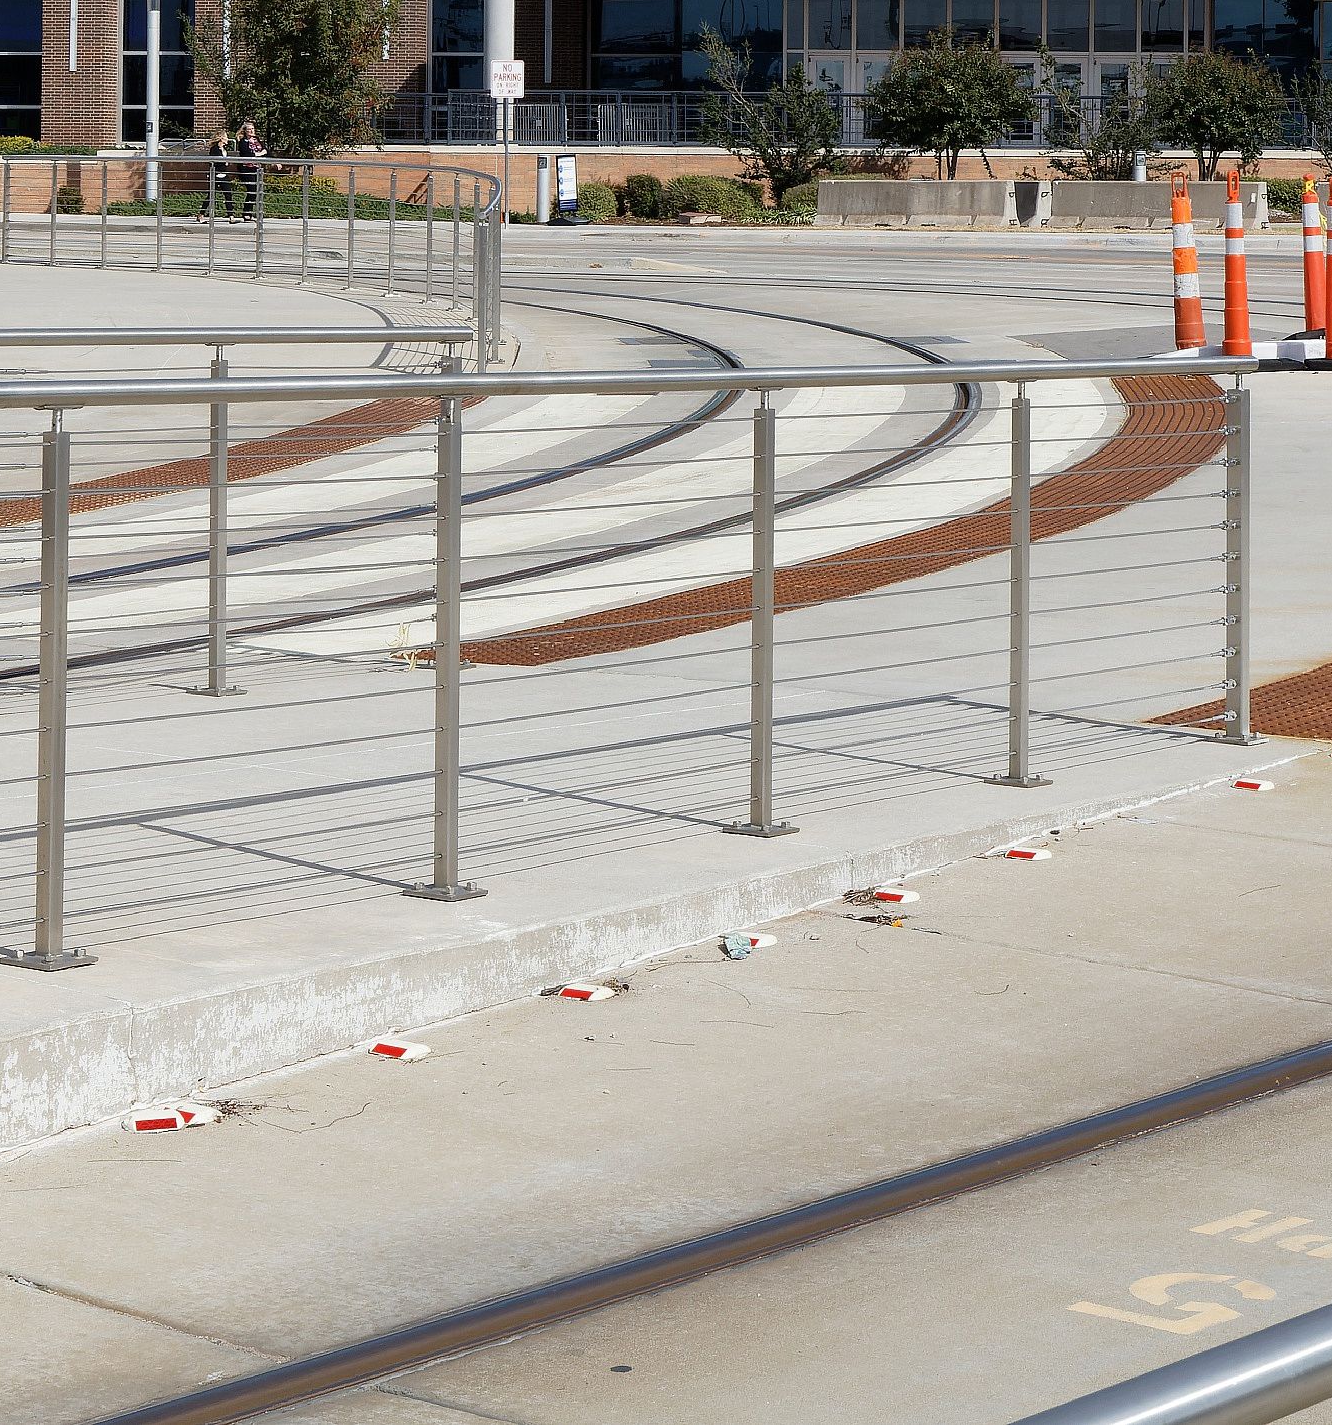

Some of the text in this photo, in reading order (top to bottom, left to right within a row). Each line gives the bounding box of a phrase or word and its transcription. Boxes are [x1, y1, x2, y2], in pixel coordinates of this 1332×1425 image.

[502, 64, 512, 72] NO
[493, 73, 522, 81] PARKING
[1067, 1273, 1277, 1335] 5
